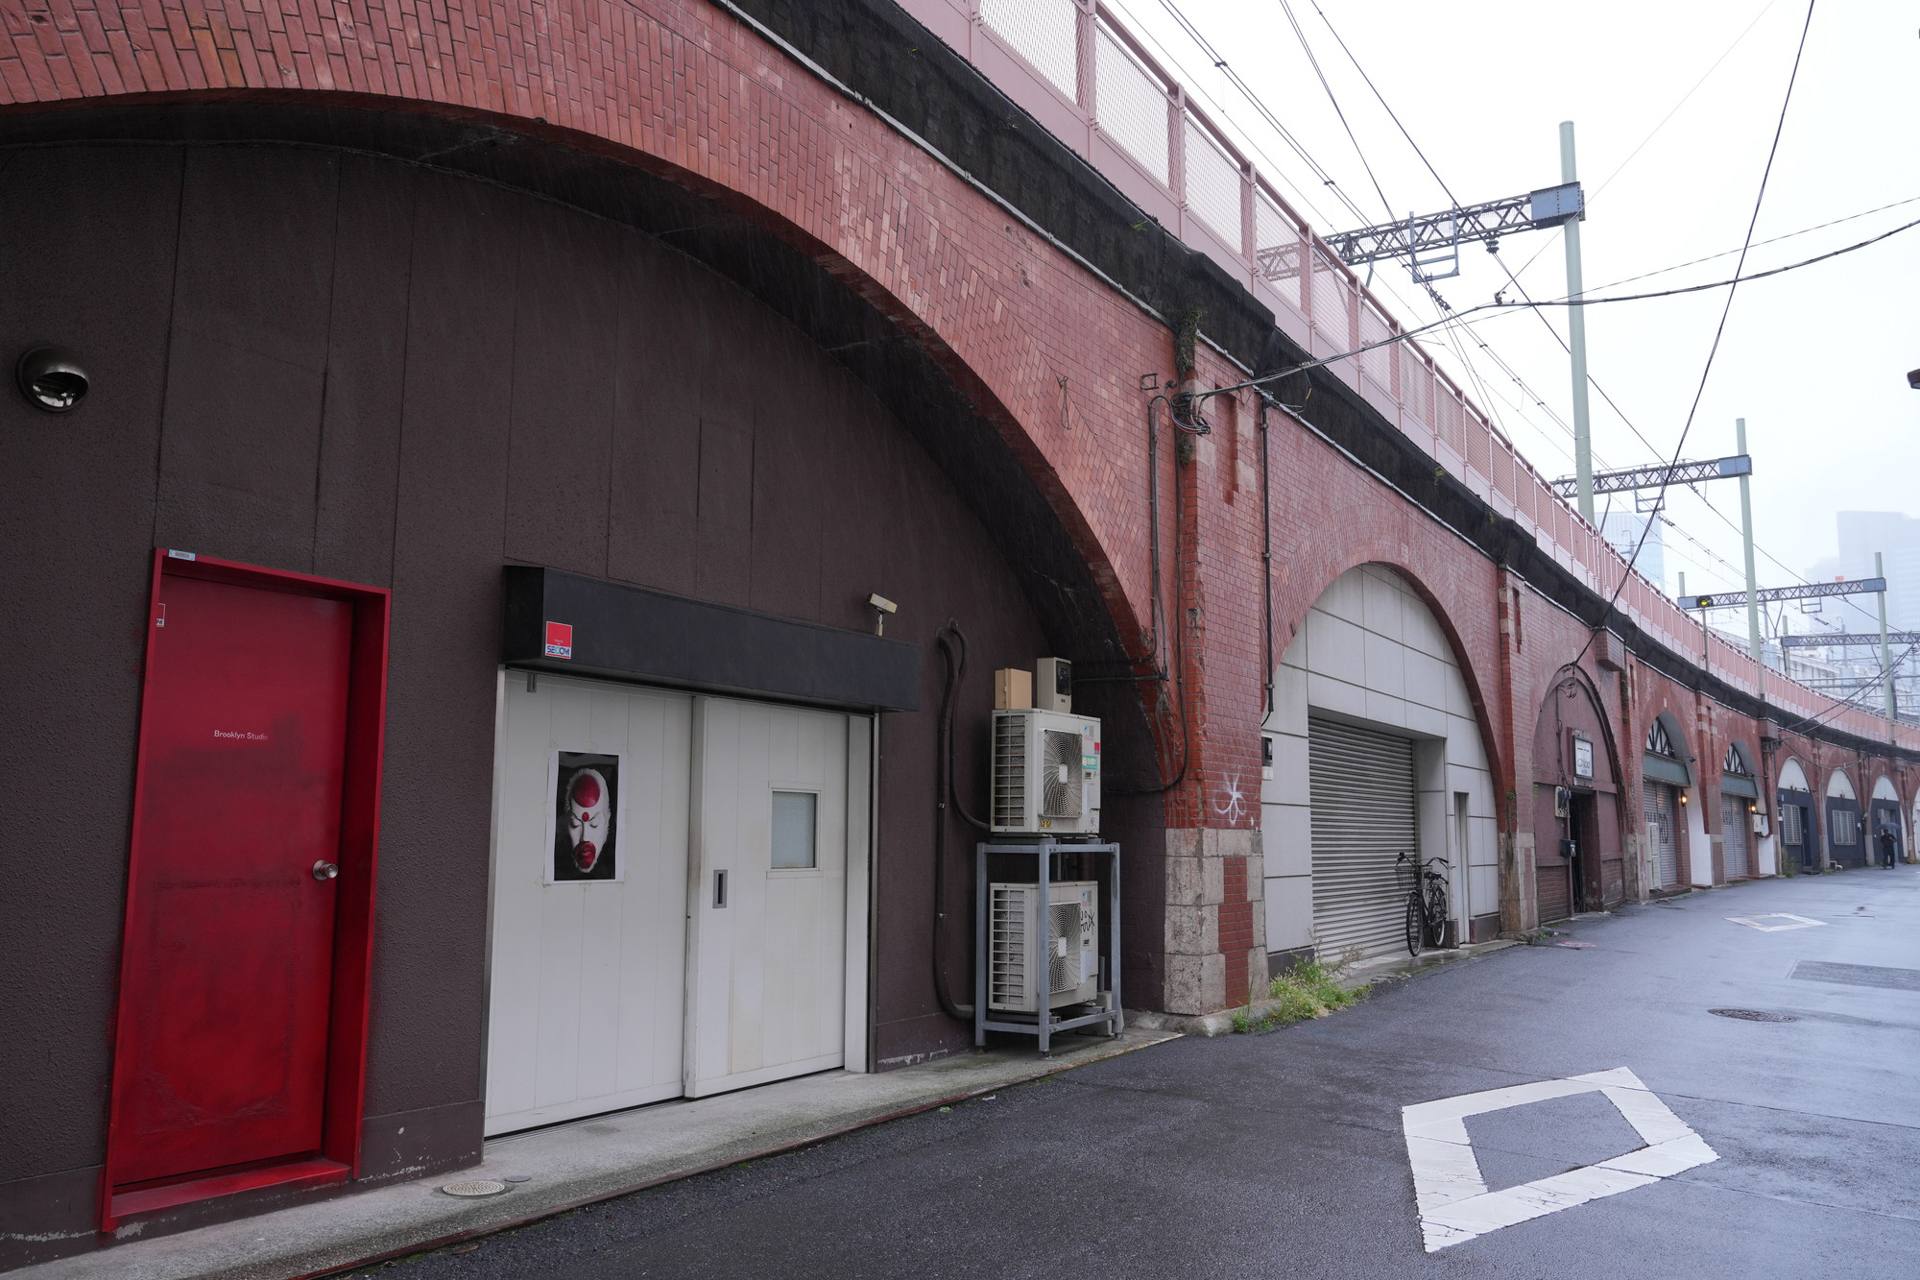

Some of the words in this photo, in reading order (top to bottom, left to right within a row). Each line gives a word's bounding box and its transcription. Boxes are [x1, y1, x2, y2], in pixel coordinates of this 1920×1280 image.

[547, 645, 570, 655] SECOM
[214, 730, 246, 740] Brooklyn
[246, 732, 268, 740] Studio
